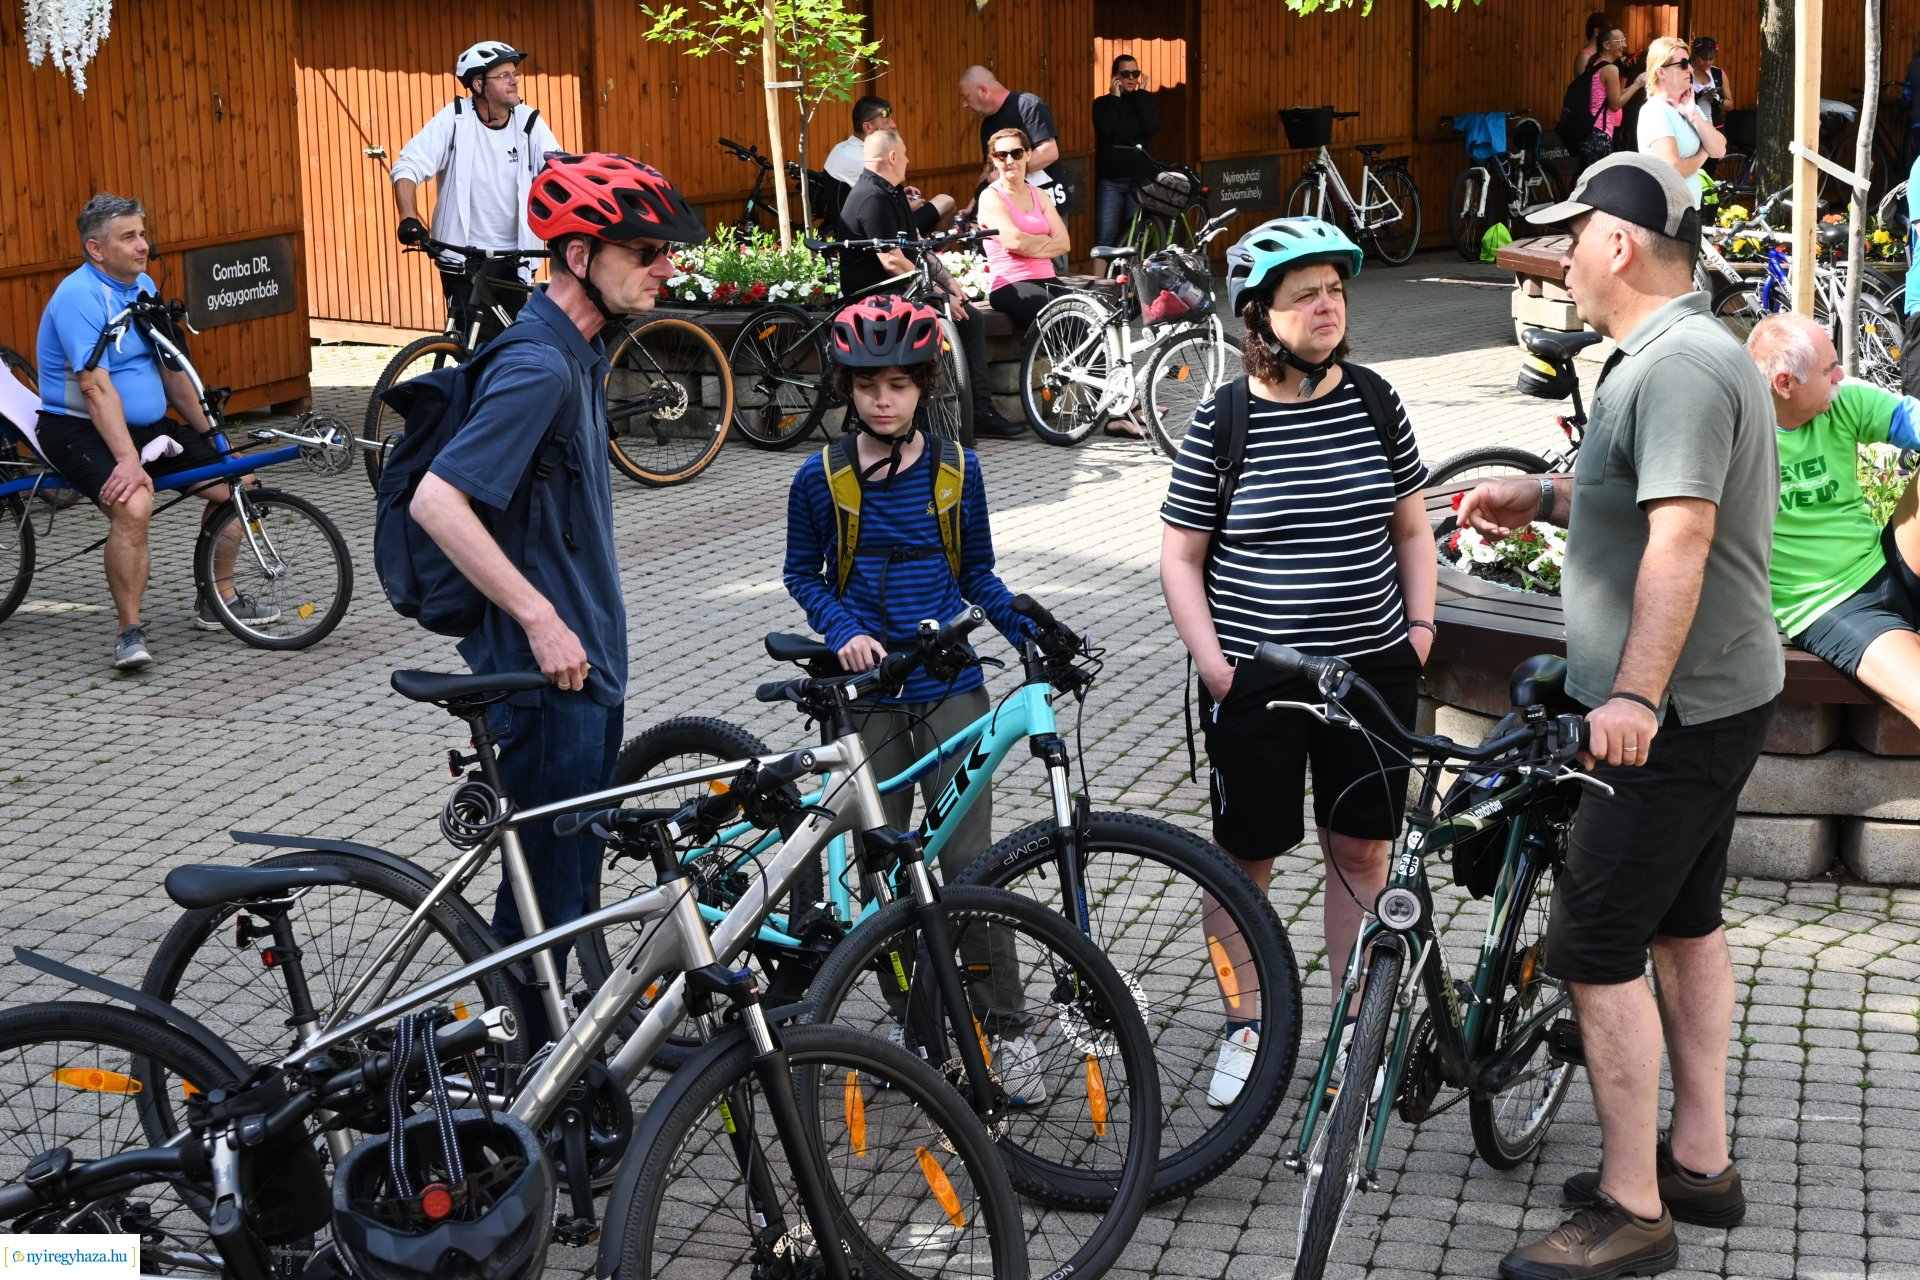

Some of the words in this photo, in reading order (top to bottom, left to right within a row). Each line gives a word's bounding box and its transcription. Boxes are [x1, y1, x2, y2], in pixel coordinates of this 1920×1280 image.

[212, 260, 251, 281] Gomba
[252, 256, 271, 275] DR.
[207, 279, 279, 310] gyógygombák
[1003, 836, 1050, 866] COMP
